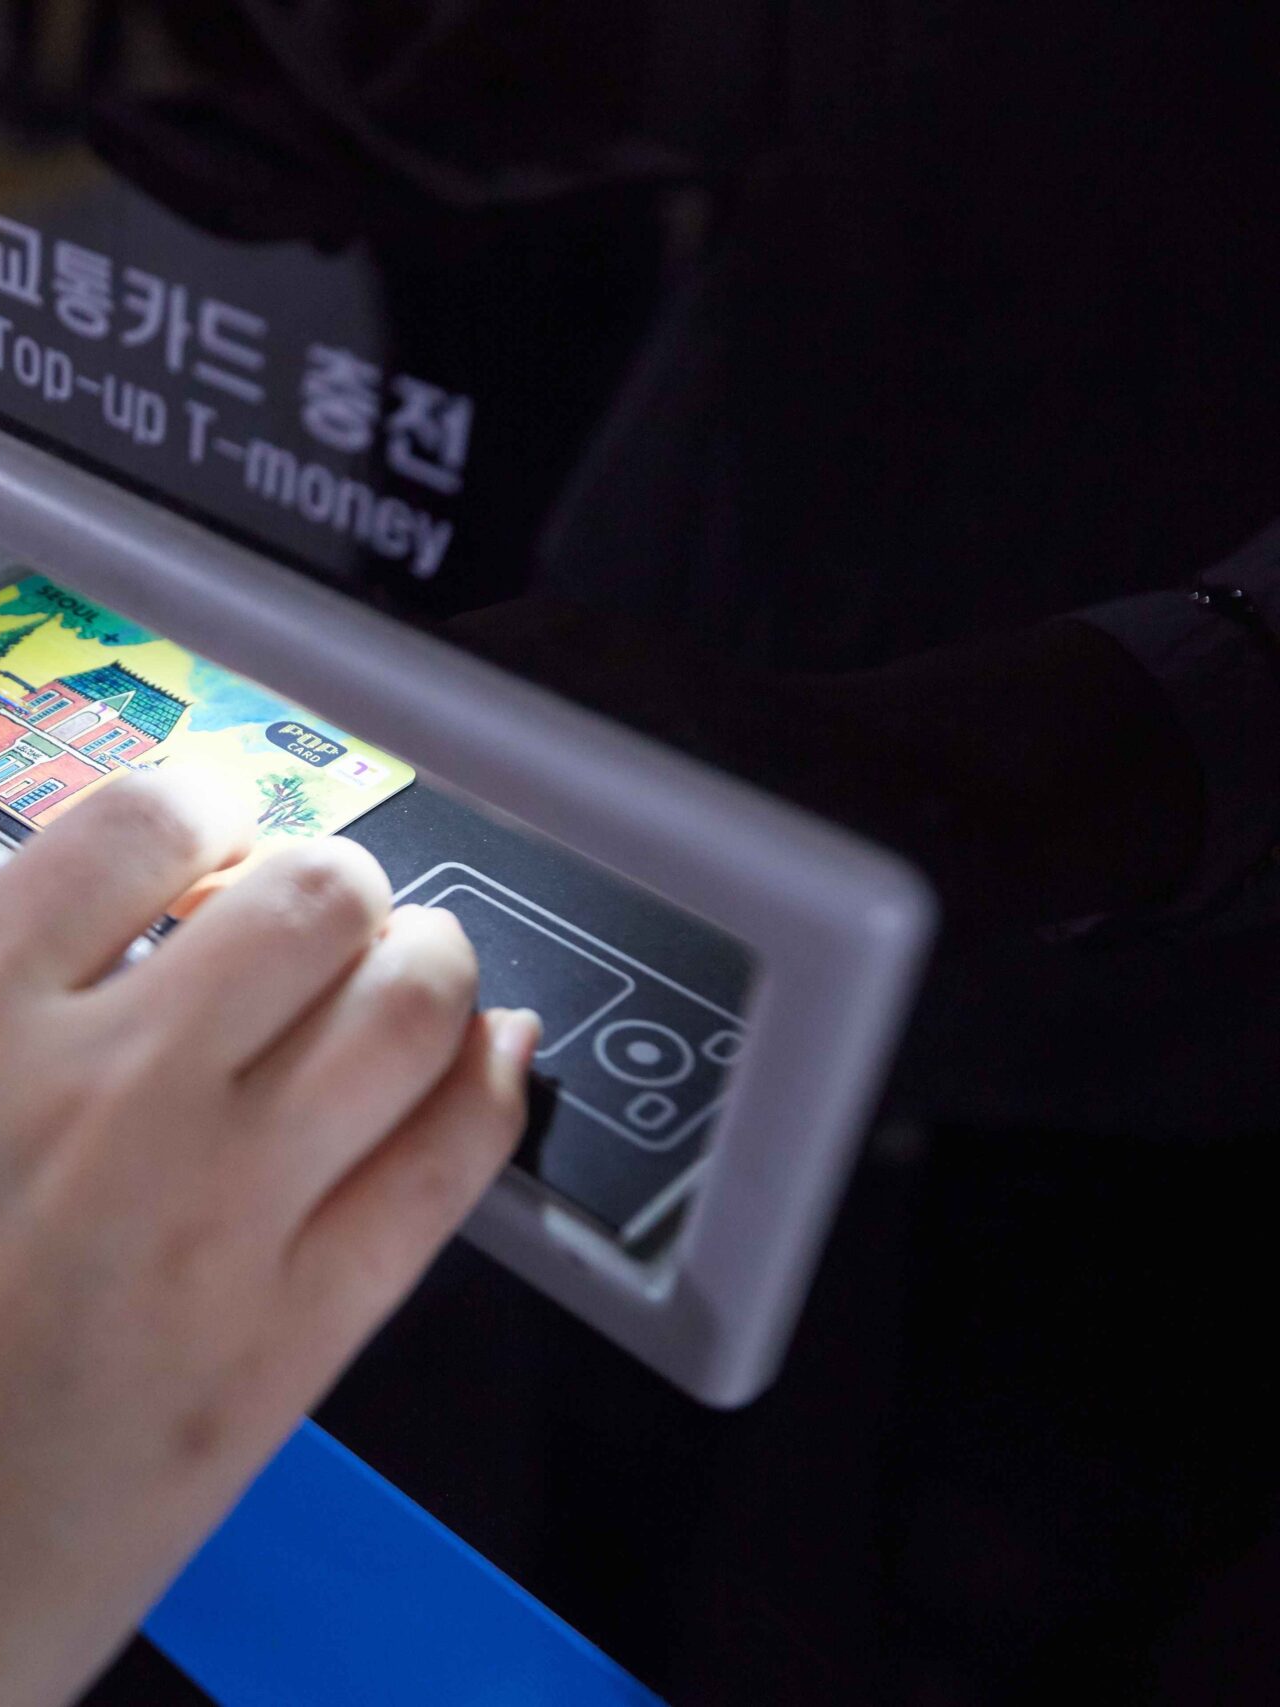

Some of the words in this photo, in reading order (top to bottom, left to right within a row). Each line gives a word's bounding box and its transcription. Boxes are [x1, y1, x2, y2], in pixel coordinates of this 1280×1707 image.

[301, 343, 474, 494] 충전
[185, 398, 455, 579] T-money
[36, 584, 99, 624] SEOUL
[278, 723, 339, 756] POP
[287, 742, 321, 763] CARD
